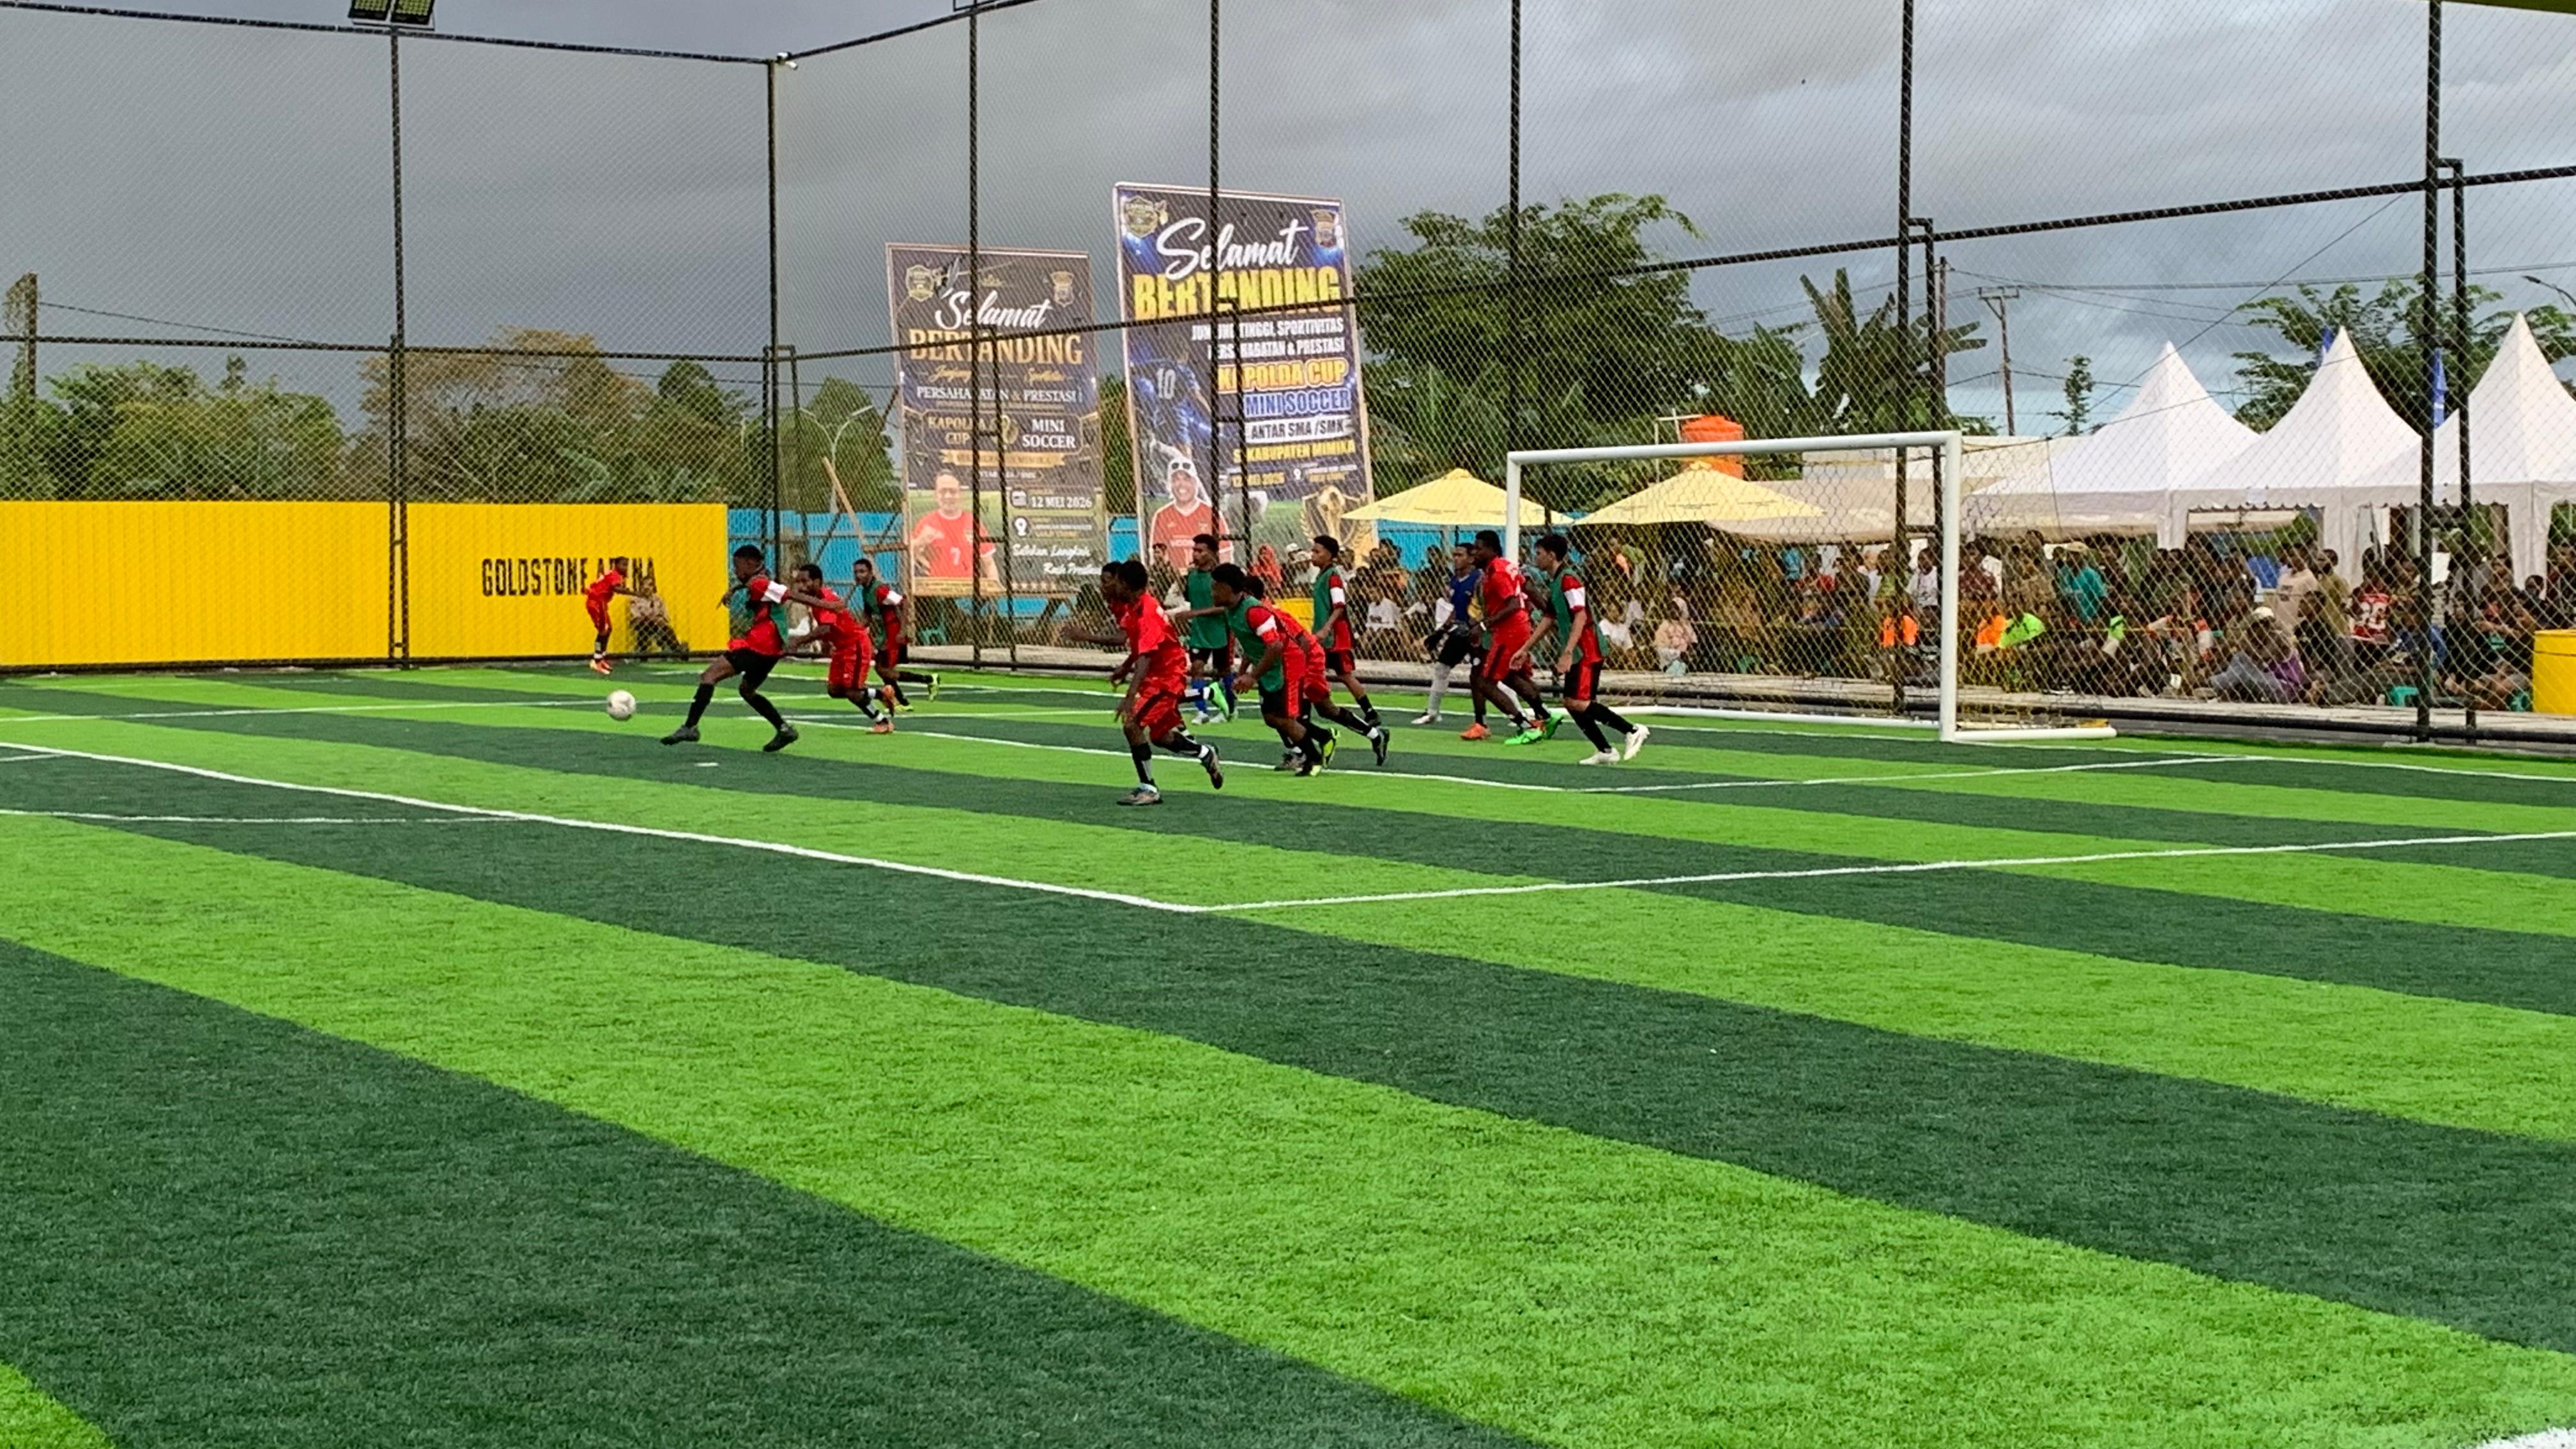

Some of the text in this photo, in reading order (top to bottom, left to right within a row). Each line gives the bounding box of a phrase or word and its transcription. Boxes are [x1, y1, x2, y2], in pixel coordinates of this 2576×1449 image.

[1156, 217, 1308, 281] Selamat
[1133, 266, 1341, 321] BERTANDING
[934, 288, 1053, 330] Selamat
[1296, 337, 1345, 352] PRESTASI
[1307, 358, 1349, 385] CUP
[1156, 369, 1176, 399] 10
[916, 386, 1009, 401] PERSAHAATN
[1245, 390, 1350, 415] MINI SOCCER
[928, 417, 987, 431] KAPOLA
[1032, 418, 1064, 433] MINI
[1251, 424, 1285, 440] ANTAR
[1289, 422, 1312, 438] SMA
[1022, 434, 1076, 448] SOCCER
[1031, 496, 1044, 508] 12
[950, 548, 960, 565] 7
[482, 556, 657, 597] GOLDSTONE ANA
